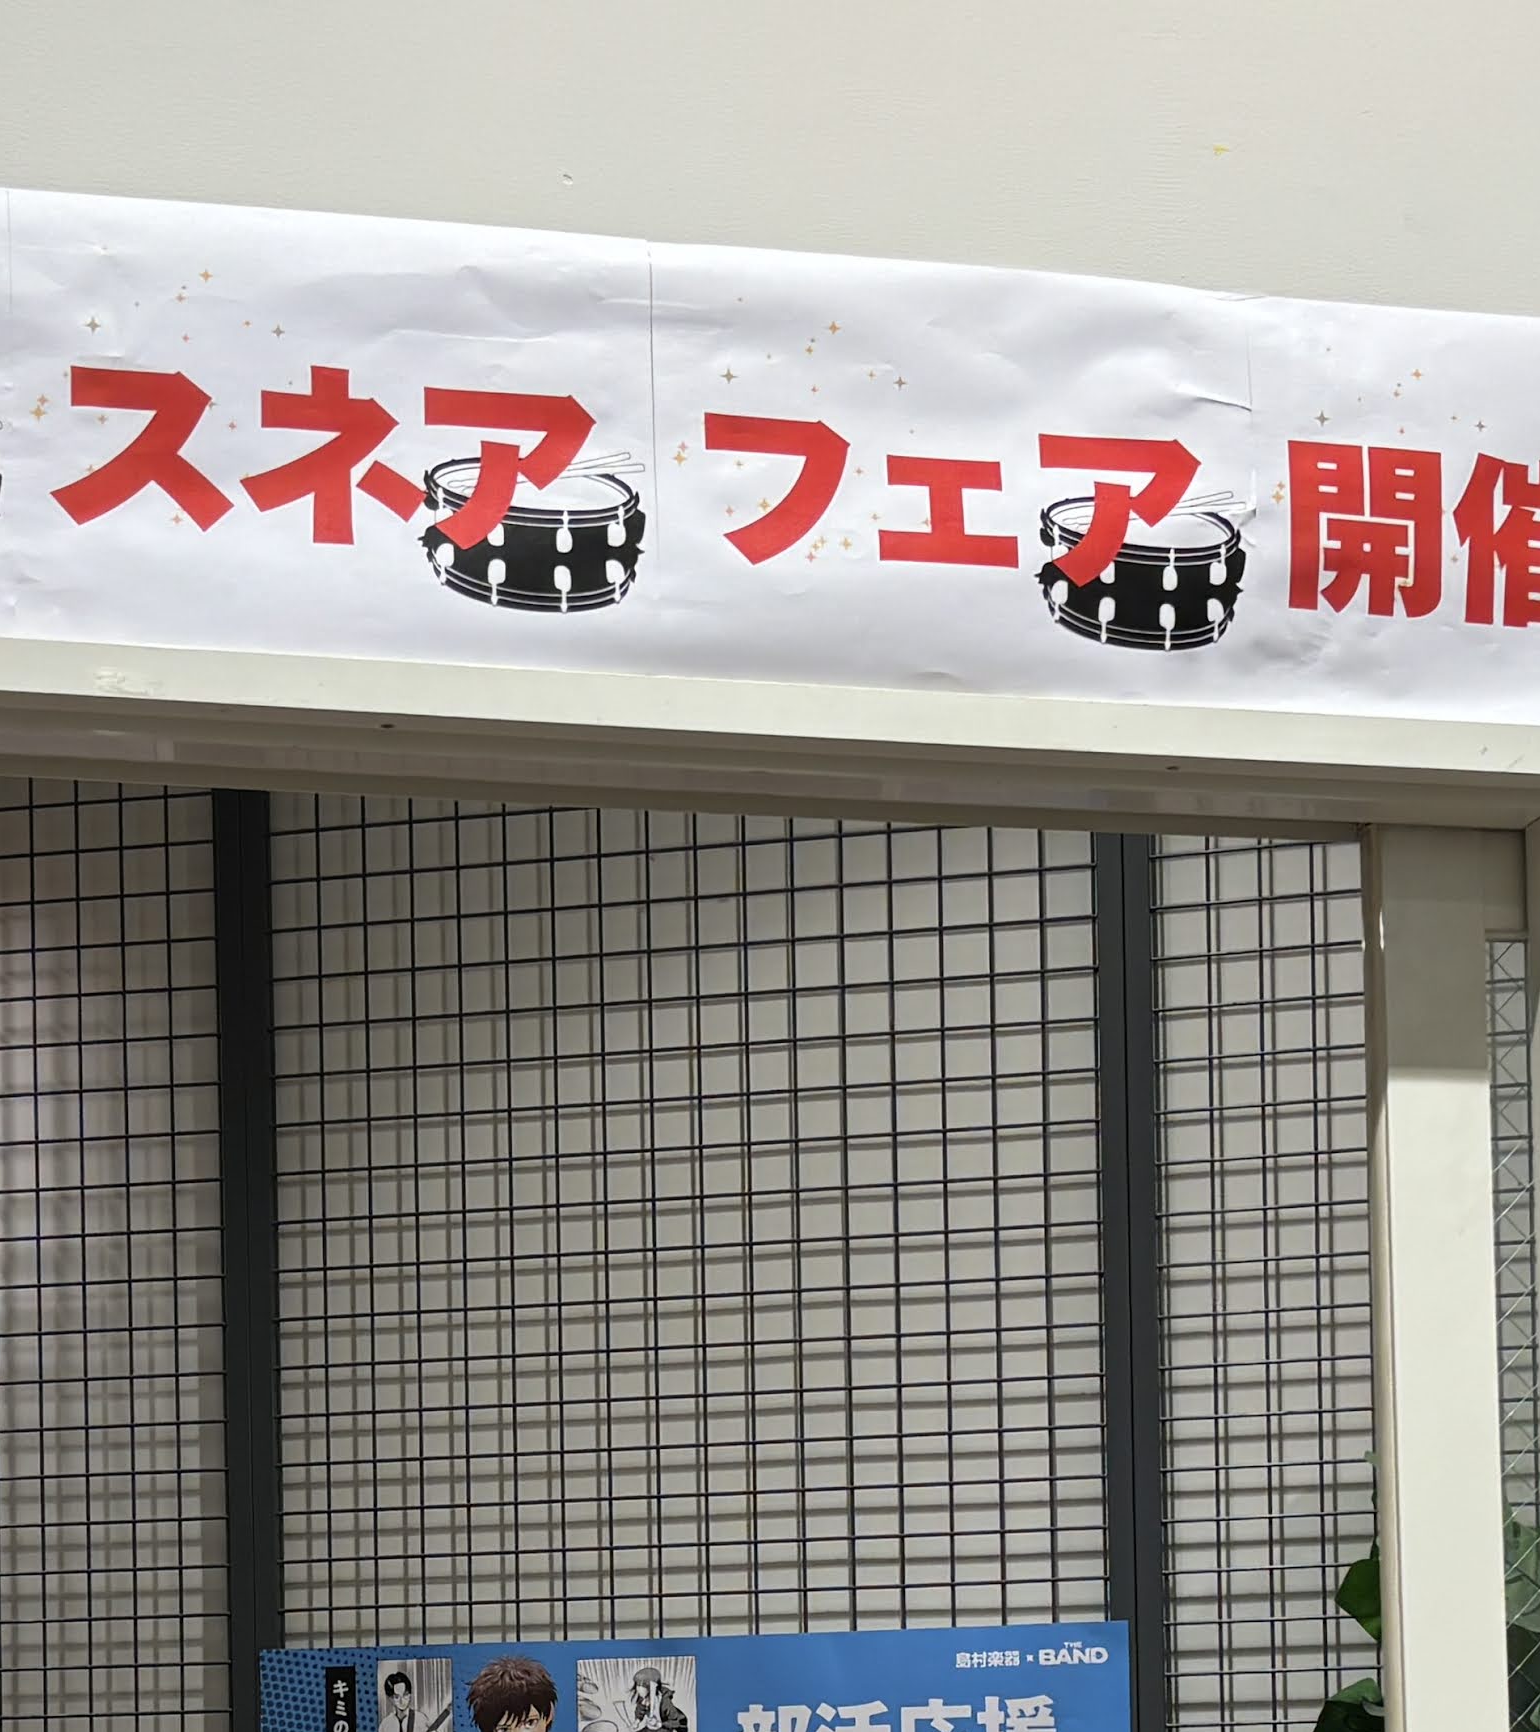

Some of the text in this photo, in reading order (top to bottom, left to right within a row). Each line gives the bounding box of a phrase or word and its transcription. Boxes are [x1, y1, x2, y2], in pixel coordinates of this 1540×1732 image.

[49, 365, 596, 550] スネア
[704, 410, 1202, 587] フェア
[955, 1646, 1109, 1668] 島村楽器 BAND
